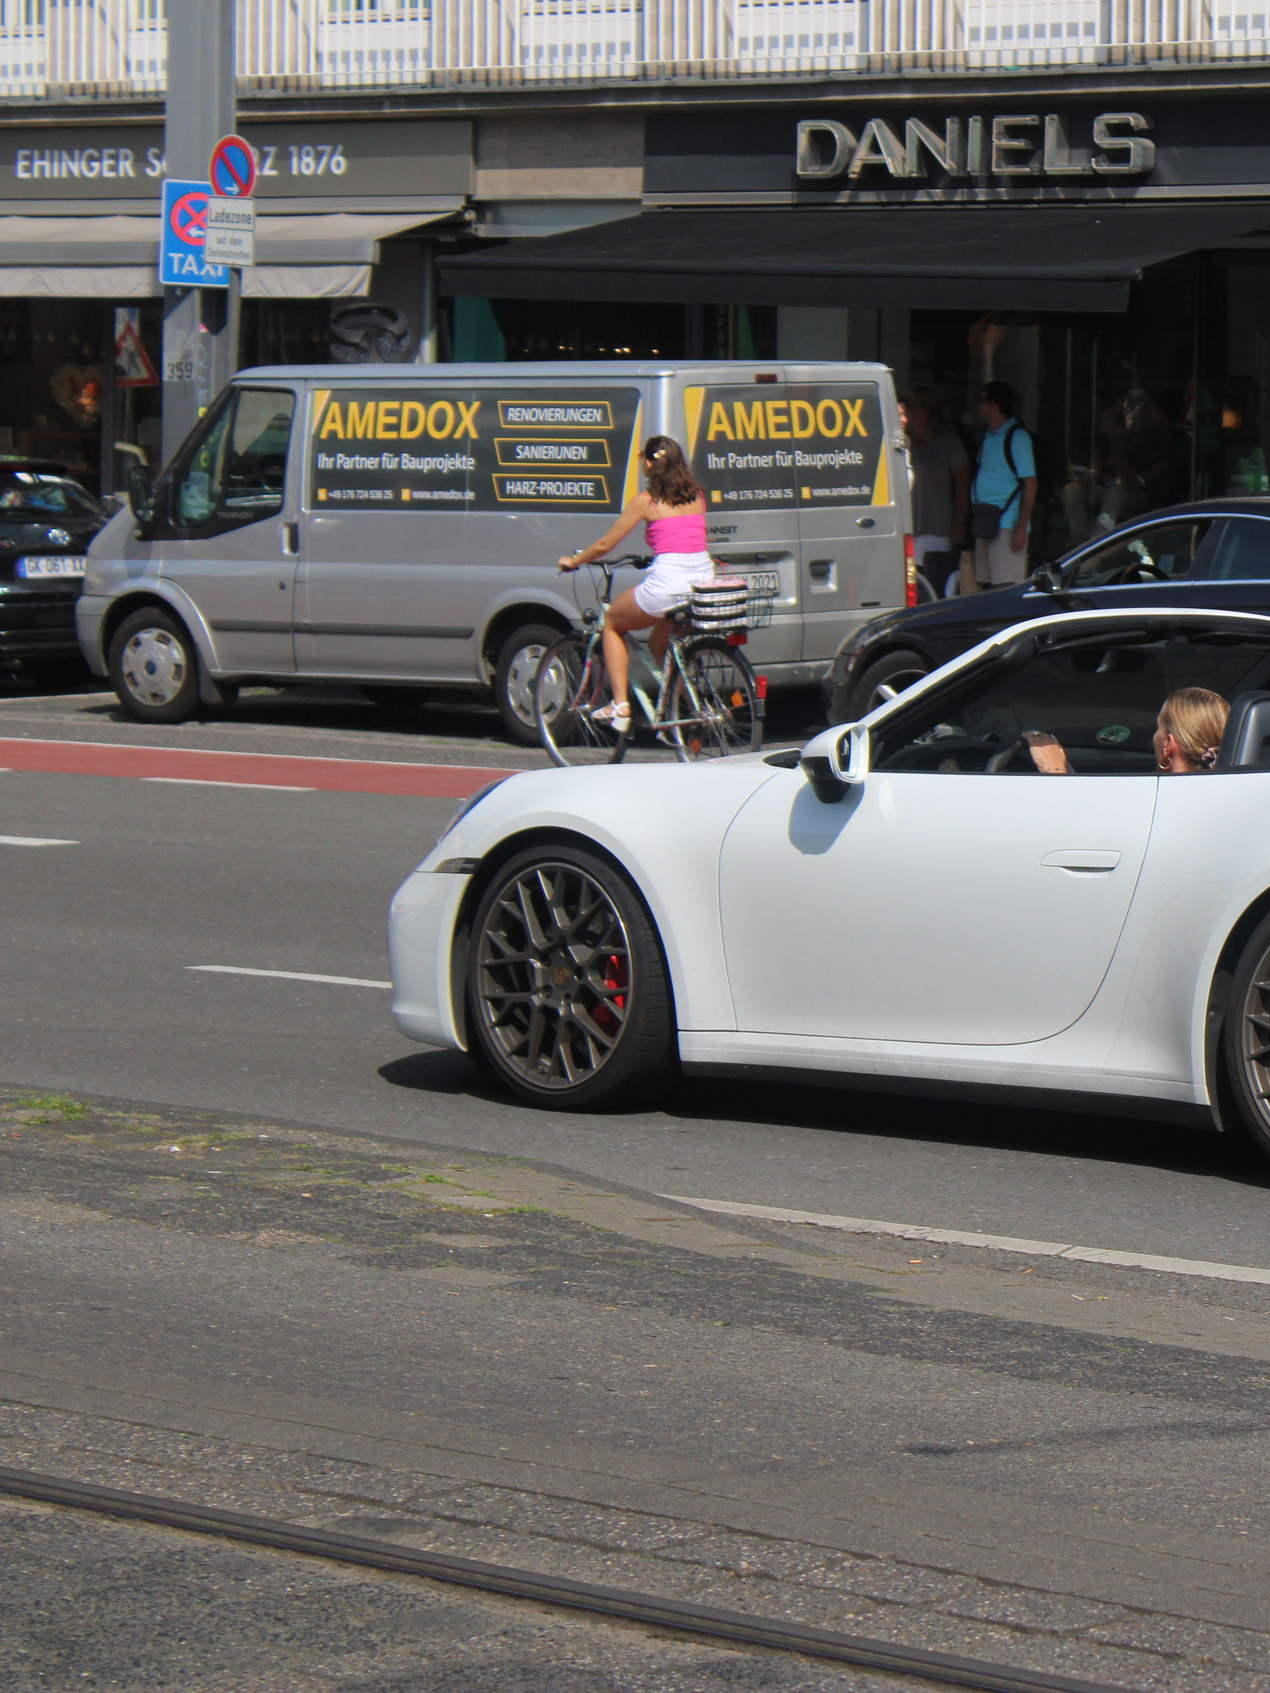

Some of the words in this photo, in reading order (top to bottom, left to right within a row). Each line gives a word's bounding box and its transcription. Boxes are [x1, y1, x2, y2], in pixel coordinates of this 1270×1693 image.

[796, 112, 1156, 179] DANIELS
[16, 149, 136, 179] EHINGER
[288, 145, 346, 176] 1876
[208, 206, 252, 225] Ladezone
[215, 235, 228, 247] auf
[229, 235, 243, 247] dem
[206, 247, 251, 261] Seitenstreifen
[167, 361, 194, 380] 359
[319, 400, 482, 440] AMEDOX
[507, 407, 602, 422] RENOVIERUNGEN
[707, 398, 868, 441] AMEDOX
[515, 444, 589, 460] SANIERUNEN
[707, 453, 726, 470] Ihr
[728, 451, 773, 469] Partner
[775, 451, 793, 467] für
[795, 448, 864, 471] Bauprojekte
[318, 453, 334, 469] Ihr
[336, 453, 379, 470] Partner
[381, 452, 400, 470] für
[401, 453, 476, 474] Bauprojekte
[328, 489, 341, 500] +49
[342, 489, 355, 500] 176
[356, 489, 369, 500] 724
[383, 489, 393, 500] 25
[412, 489, 476, 500] www.amedox.de
[505, 481, 596, 496] HARZ-PROJEKTE
[723, 491, 737, 501] +49
[739, 490, 753, 500] 176
[754, 489, 768, 500] 724
[768, 488, 783, 499] 536
[784, 488, 794, 498] 25
[812, 485, 872, 497] www.amedox.de
[751, 574, 778, 591] 2021
